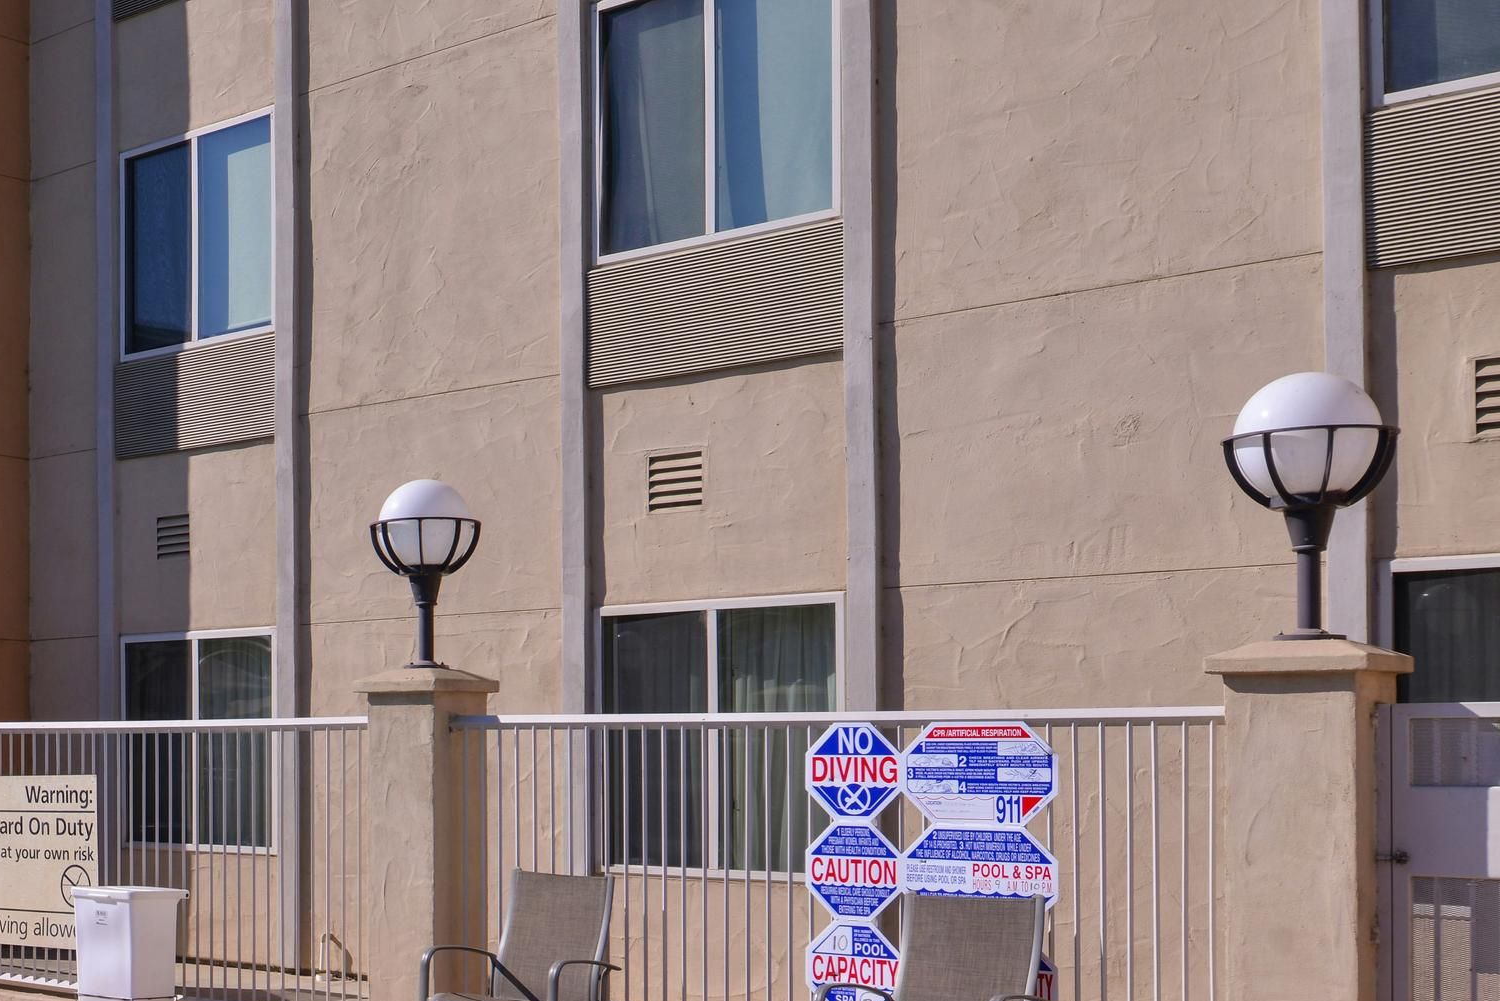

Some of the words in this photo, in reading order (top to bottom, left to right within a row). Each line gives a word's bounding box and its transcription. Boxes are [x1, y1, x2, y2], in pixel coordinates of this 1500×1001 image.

[838, 727, 873, 755] NO
[981, 729, 1022, 738] RESPIRATION
[812, 756, 898, 784] DIVING
[908, 768, 914, 778] 3
[959, 756, 967, 768] 2
[25, 785, 93, 809] Warning:
[959, 782, 966, 793] 4
[996, 796, 1021, 823] 911
[29, 816, 50, 836] On
[56, 817, 94, 842] Duty
[0, 847, 12, 859] at
[15, 849, 41, 863] your
[44, 850, 70, 861] own
[73, 846, 94, 862] risk
[811, 857, 896, 885] CAUTION
[972, 863, 1009, 878] POOL
[1013, 865, 1021, 880] &
[1025, 865, 1051, 881] SPA
[33, 916, 76, 939] allow
[854, 943, 887, 957] POOL
[812, 955, 899, 987] CAPACITY
